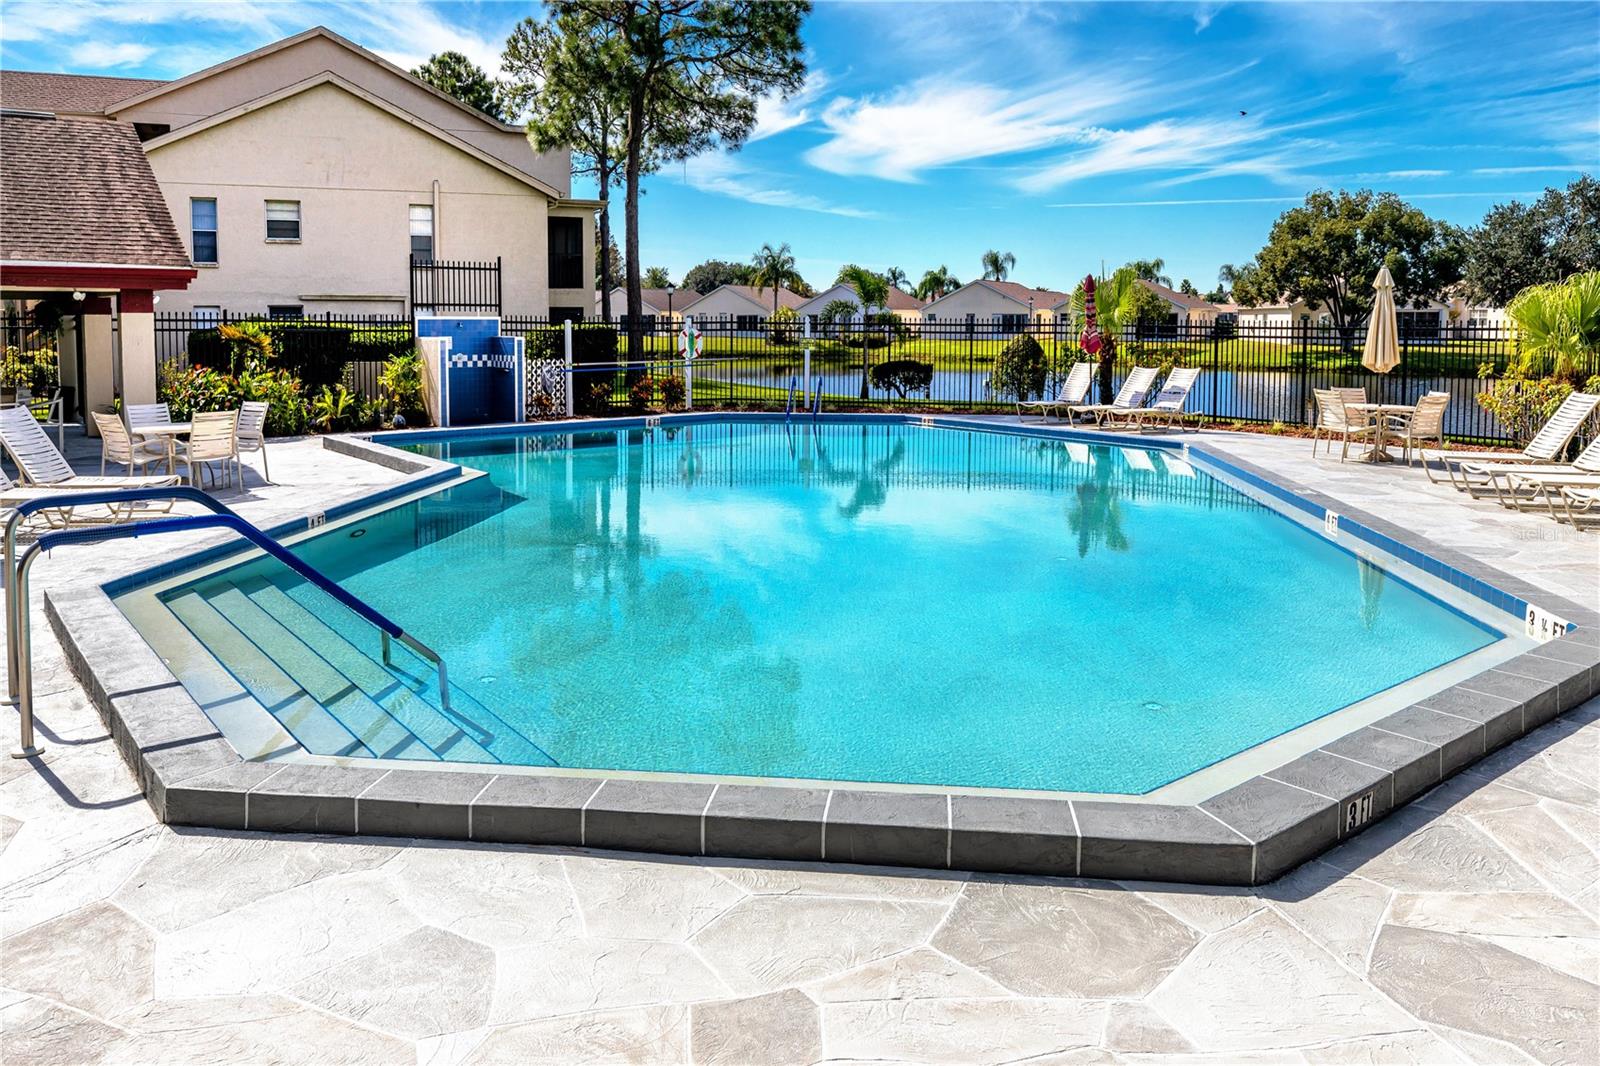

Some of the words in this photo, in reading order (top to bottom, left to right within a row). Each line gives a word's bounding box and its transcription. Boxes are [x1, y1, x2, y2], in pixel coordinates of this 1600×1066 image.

[1529, 609, 1535, 626] 3
[1552, 621, 1565, 636] FT
[1349, 801, 1357, 829] 3
[1360, 793, 1372, 825] FT
